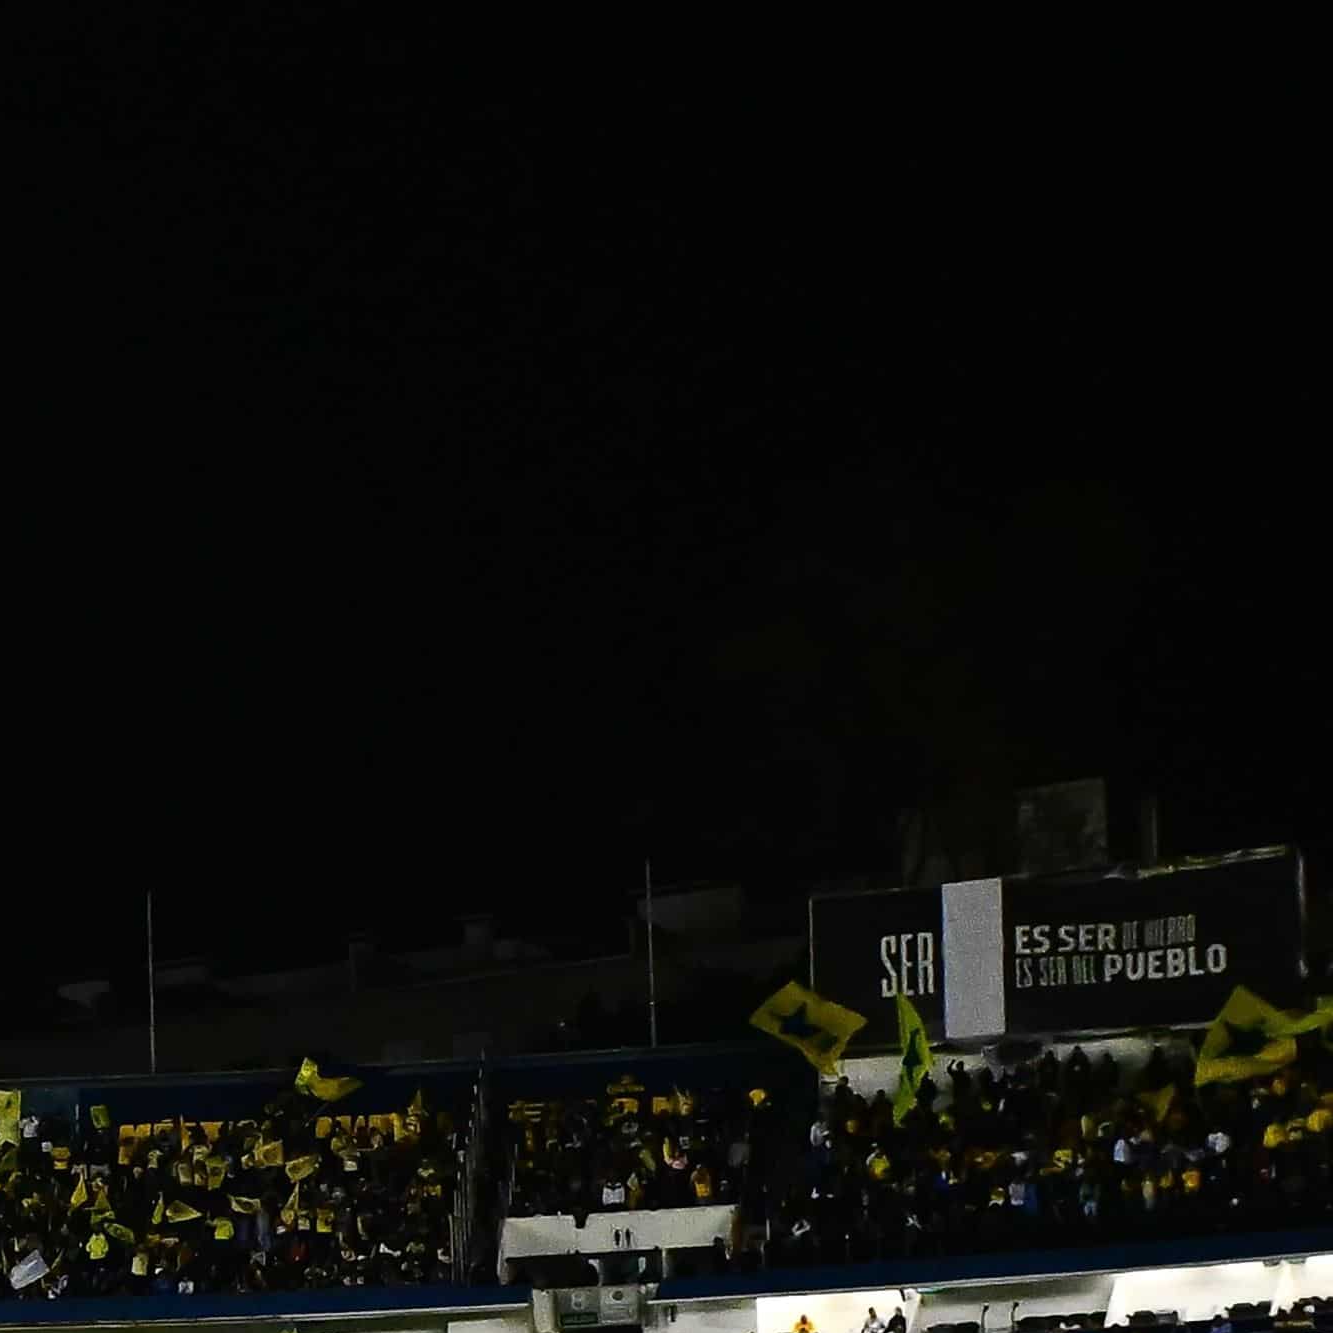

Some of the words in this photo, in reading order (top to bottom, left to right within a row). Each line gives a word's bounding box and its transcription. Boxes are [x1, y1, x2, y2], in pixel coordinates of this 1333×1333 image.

[1015, 925, 1051, 955] ES
[1058, 923, 1117, 952] SER
[880, 932, 934, 998] SER
[1104, 943, 1228, 982] PUEBLO
